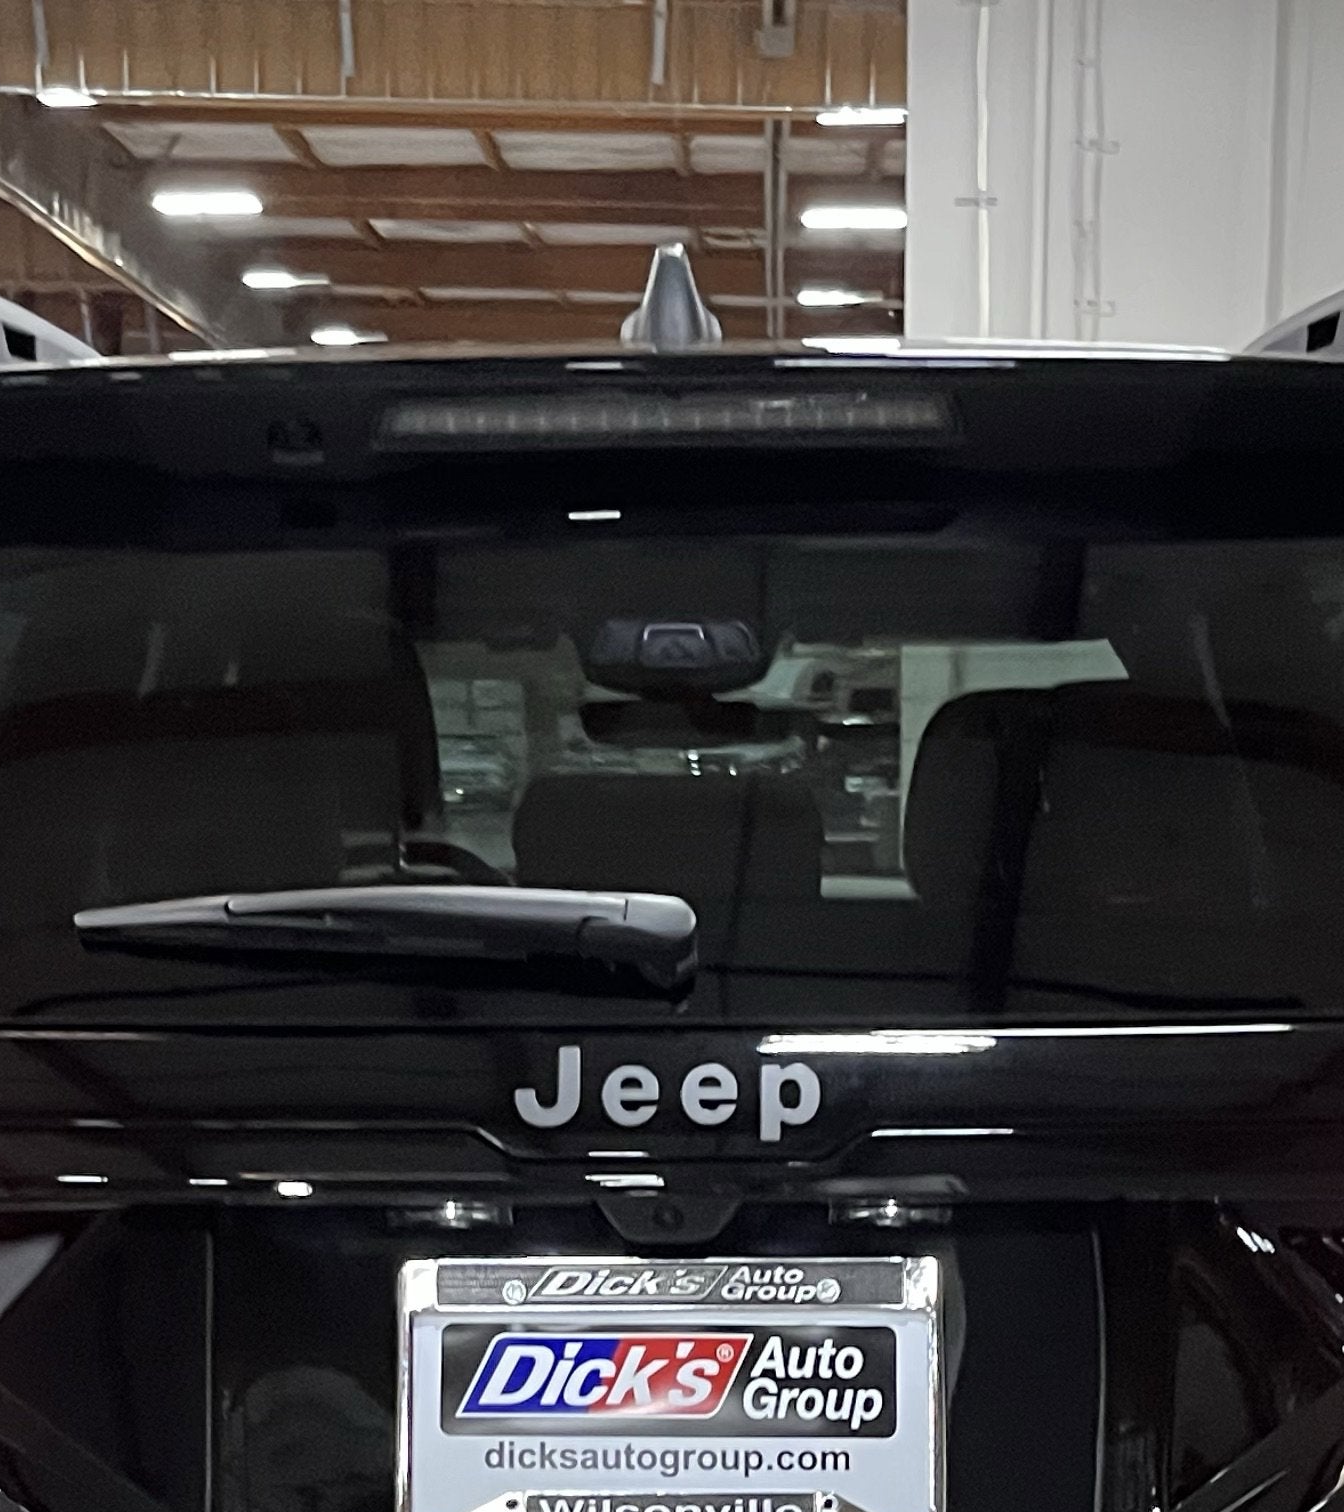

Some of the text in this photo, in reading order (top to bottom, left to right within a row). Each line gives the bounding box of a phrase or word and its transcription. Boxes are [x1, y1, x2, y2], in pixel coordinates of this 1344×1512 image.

[513, 1044, 822, 1142] Jeep
[542, 1267, 705, 1297] Dick's
[720, 1281, 817, 1304] Group
[728, 1266, 805, 1286] Auto
[478, 1341, 721, 1408] Dick's
[750, 1335, 865, 1380] Auto
[742, 1377, 884, 1431] Group
[483, 1441, 852, 1478] dicksautogroup.com
